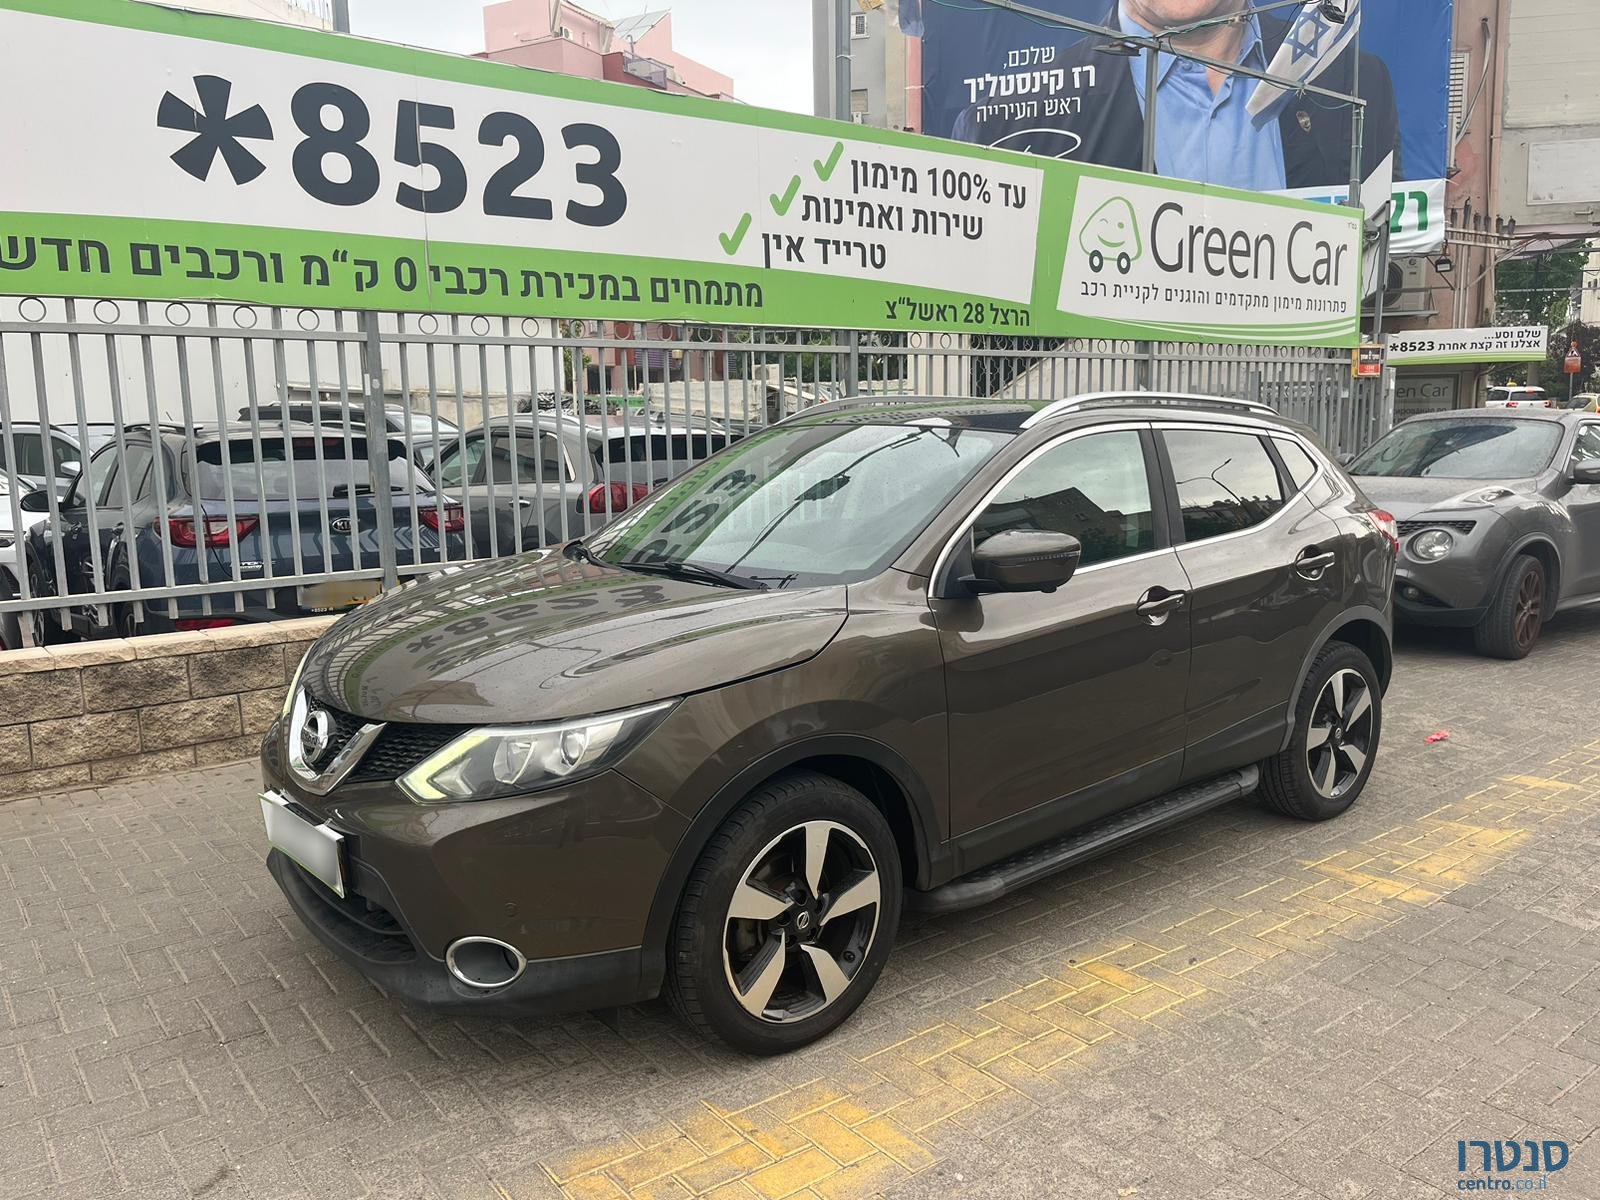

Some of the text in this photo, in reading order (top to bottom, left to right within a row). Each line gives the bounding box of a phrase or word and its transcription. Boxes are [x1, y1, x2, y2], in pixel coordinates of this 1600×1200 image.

[1003, 46, 1055, 70] שלכם,
[964, 65, 1096, 103] רז קינסטליך
[976, 96, 1081, 123] ראש העירייה
[851, 159, 1027, 209] עד 100% מימון
[801, 194, 983, 240] שירות ואמינות
[761, 232, 887, 269] טרייד אין
[1150, 201, 1348, 287] Green Car
[130, 242, 284, 284] ורכבים
[394, 256, 417, 292] 0
[429, 265, 509, 296] רכבי
[520, 269, 641, 302] במכירת
[650, 277, 763, 308] מתמחים
[963, 302, 985, 324] 28
[1080, 281, 1347, 314] פתרונות מימון מתקדמים והוגנים לקניית רכב
[990, 302, 1030, 327] הרצל
[1438, 342, 1467, 351] אחרת
[1470, 341, 1493, 351] קצת
[1496, 339, 1507, 349] זה
[1511, 339, 1540, 348] אצלנו
[1517, 329, 1541, 338] שלם
